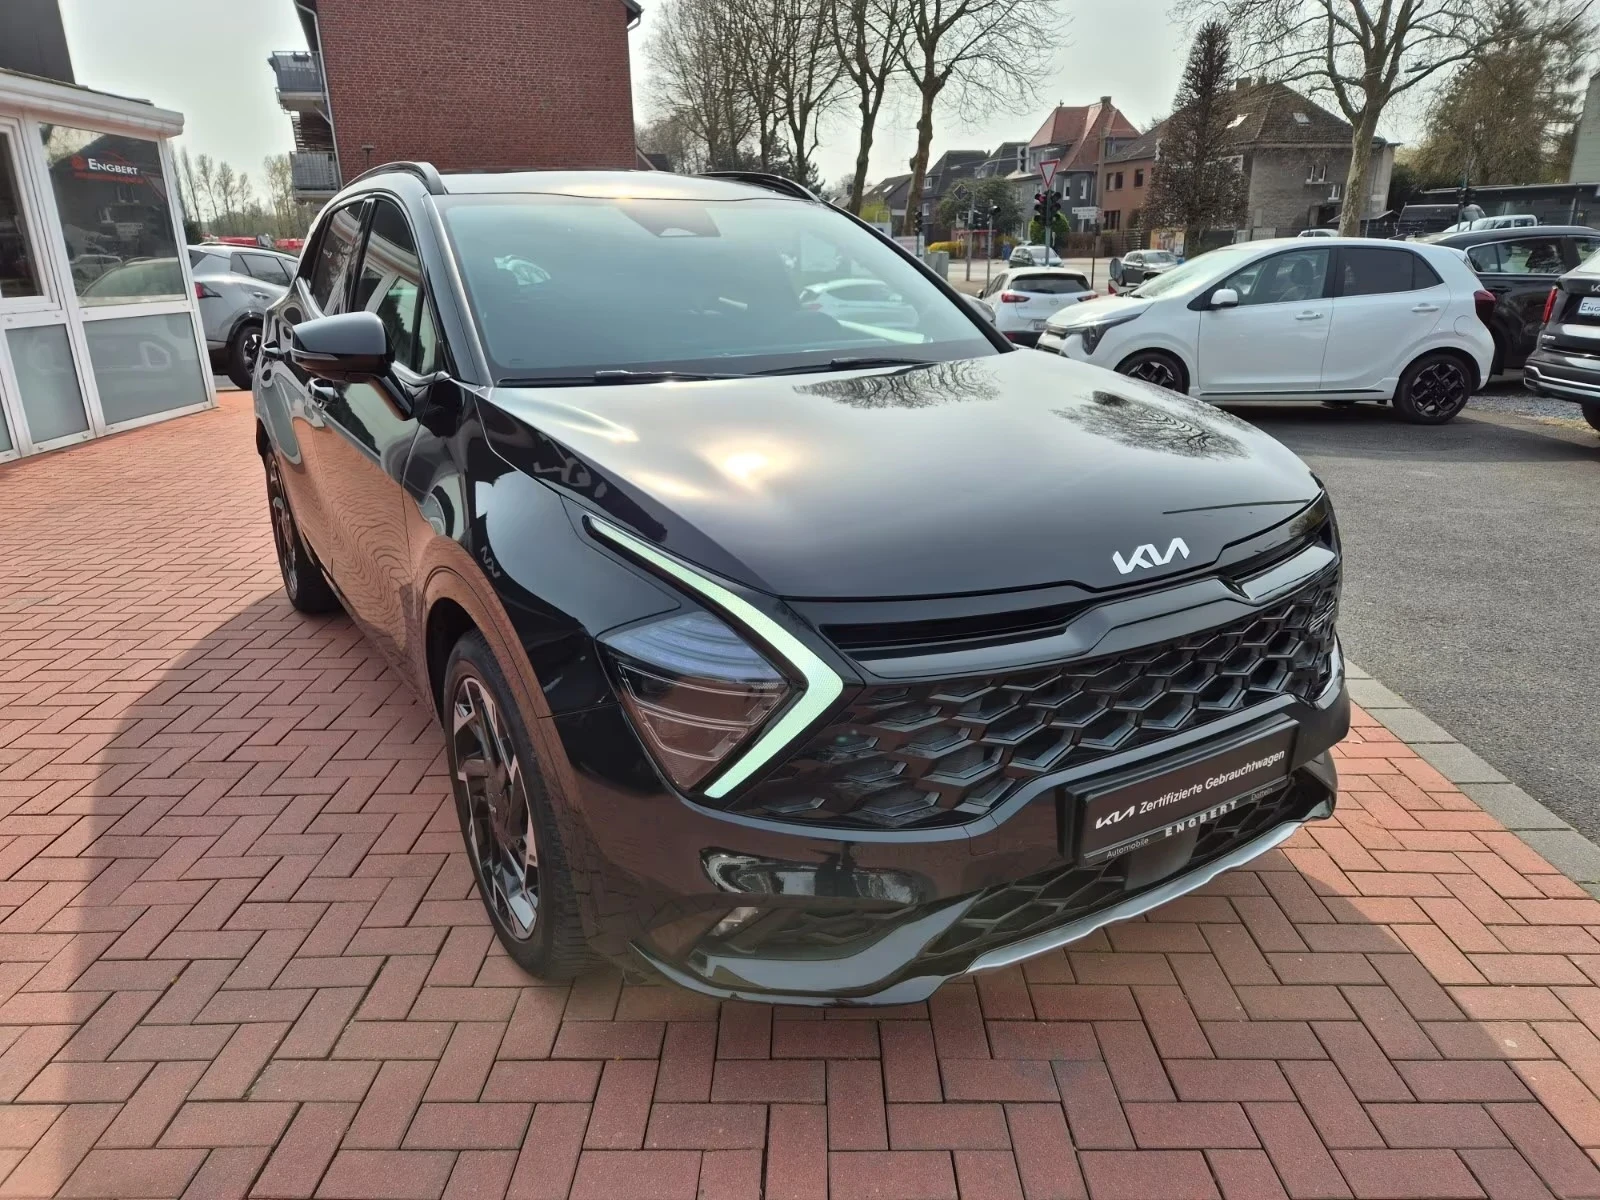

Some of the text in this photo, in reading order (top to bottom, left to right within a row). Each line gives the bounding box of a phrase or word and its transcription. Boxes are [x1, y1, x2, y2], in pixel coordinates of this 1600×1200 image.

[1112, 537, 1190, 575] KIA
[1095, 750, 1285, 830] KIA Zertifizierte Gebrauchtwagen
[1106, 838, 1149, 858] Automobile
[1165, 800, 1237, 837] ENGBERT
